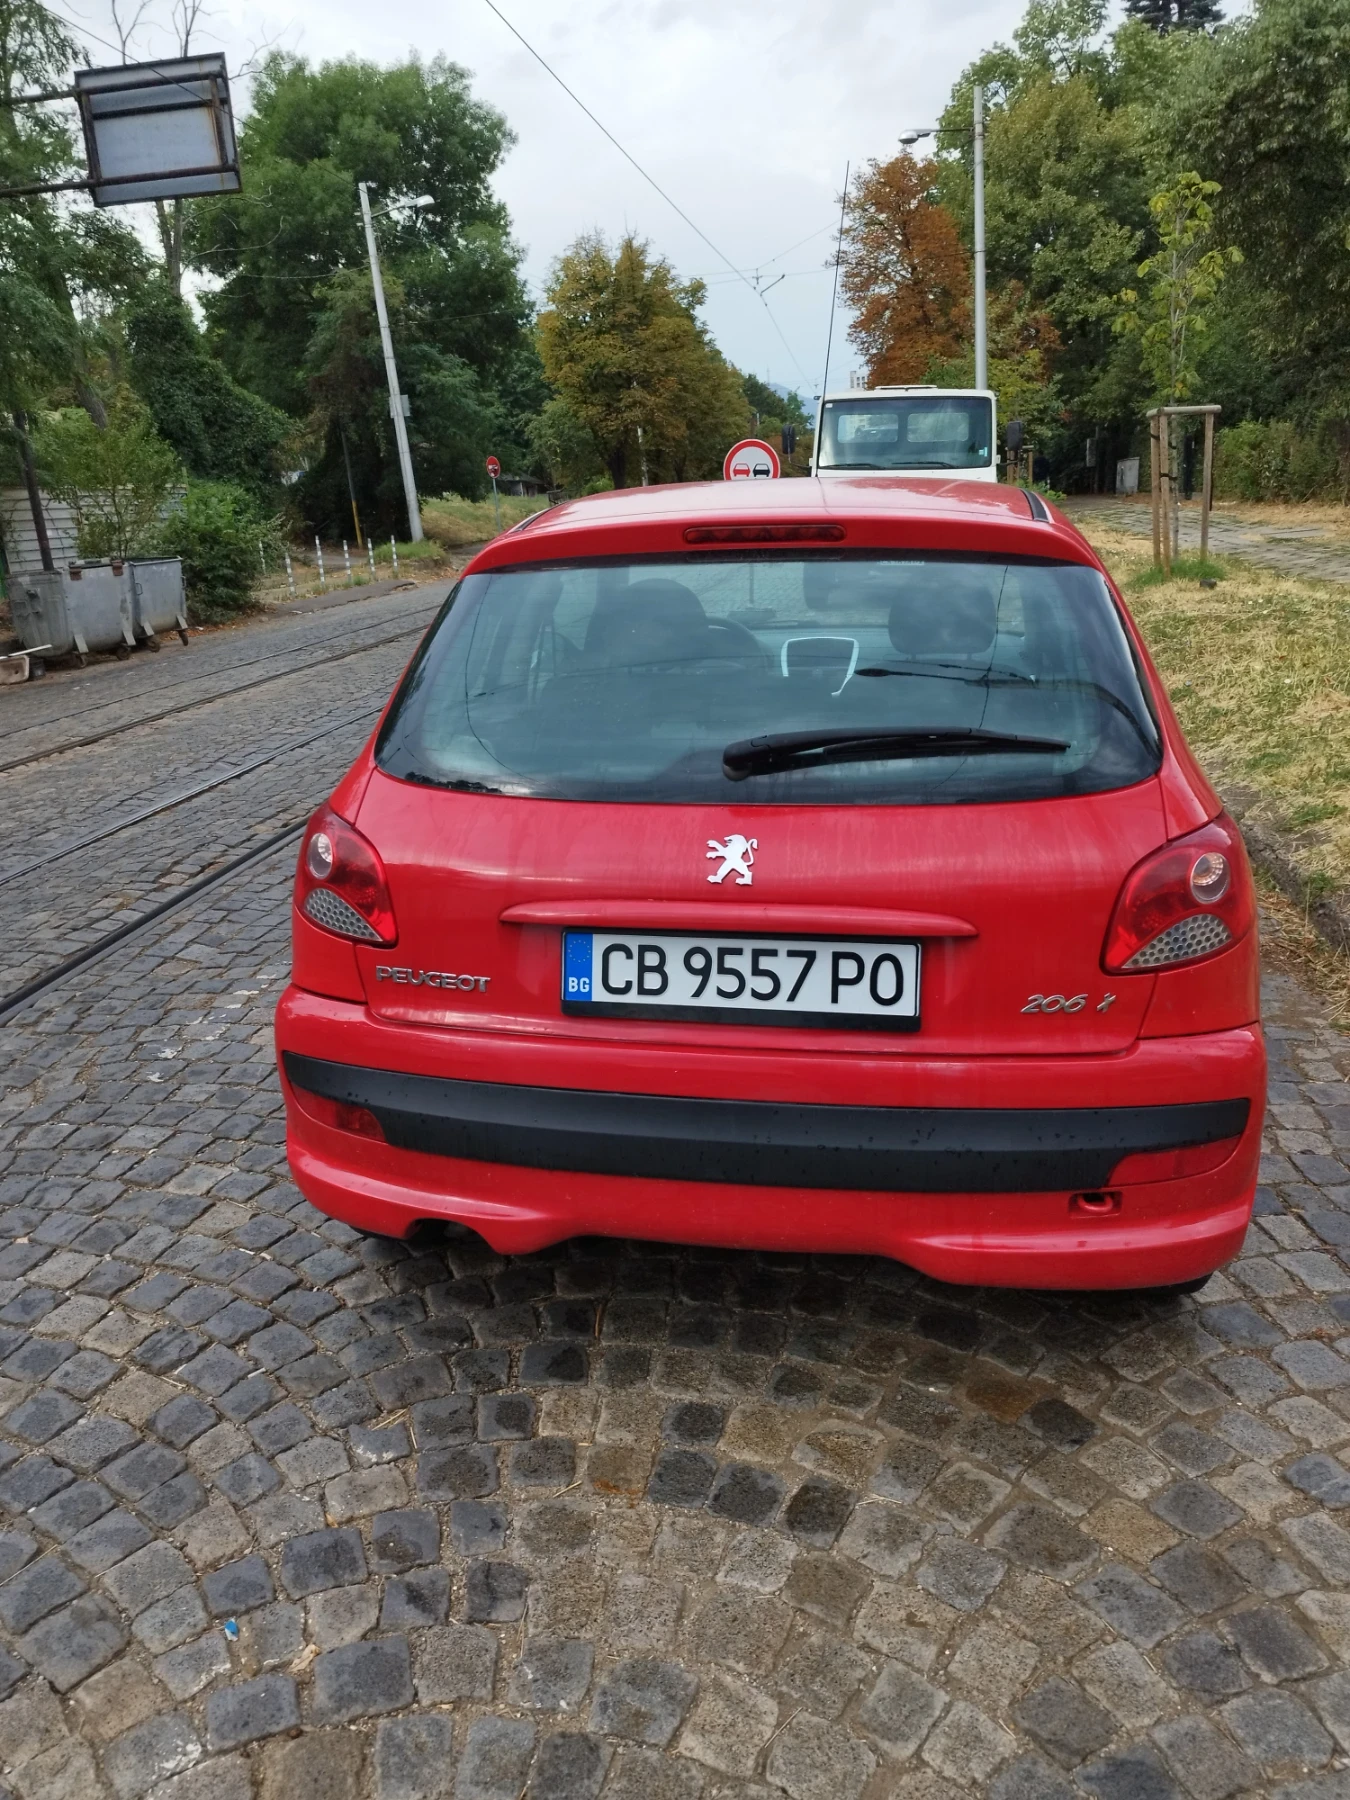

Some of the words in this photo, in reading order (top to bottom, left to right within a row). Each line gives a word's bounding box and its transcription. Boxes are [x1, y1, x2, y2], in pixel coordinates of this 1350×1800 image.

[375, 965, 491, 993] PEUGEOT
[601, 942, 669, 996] CB
[683, 946, 817, 1002] 9557
[568, 976, 590, 993] BG
[1020, 993, 1089, 1014] 206
